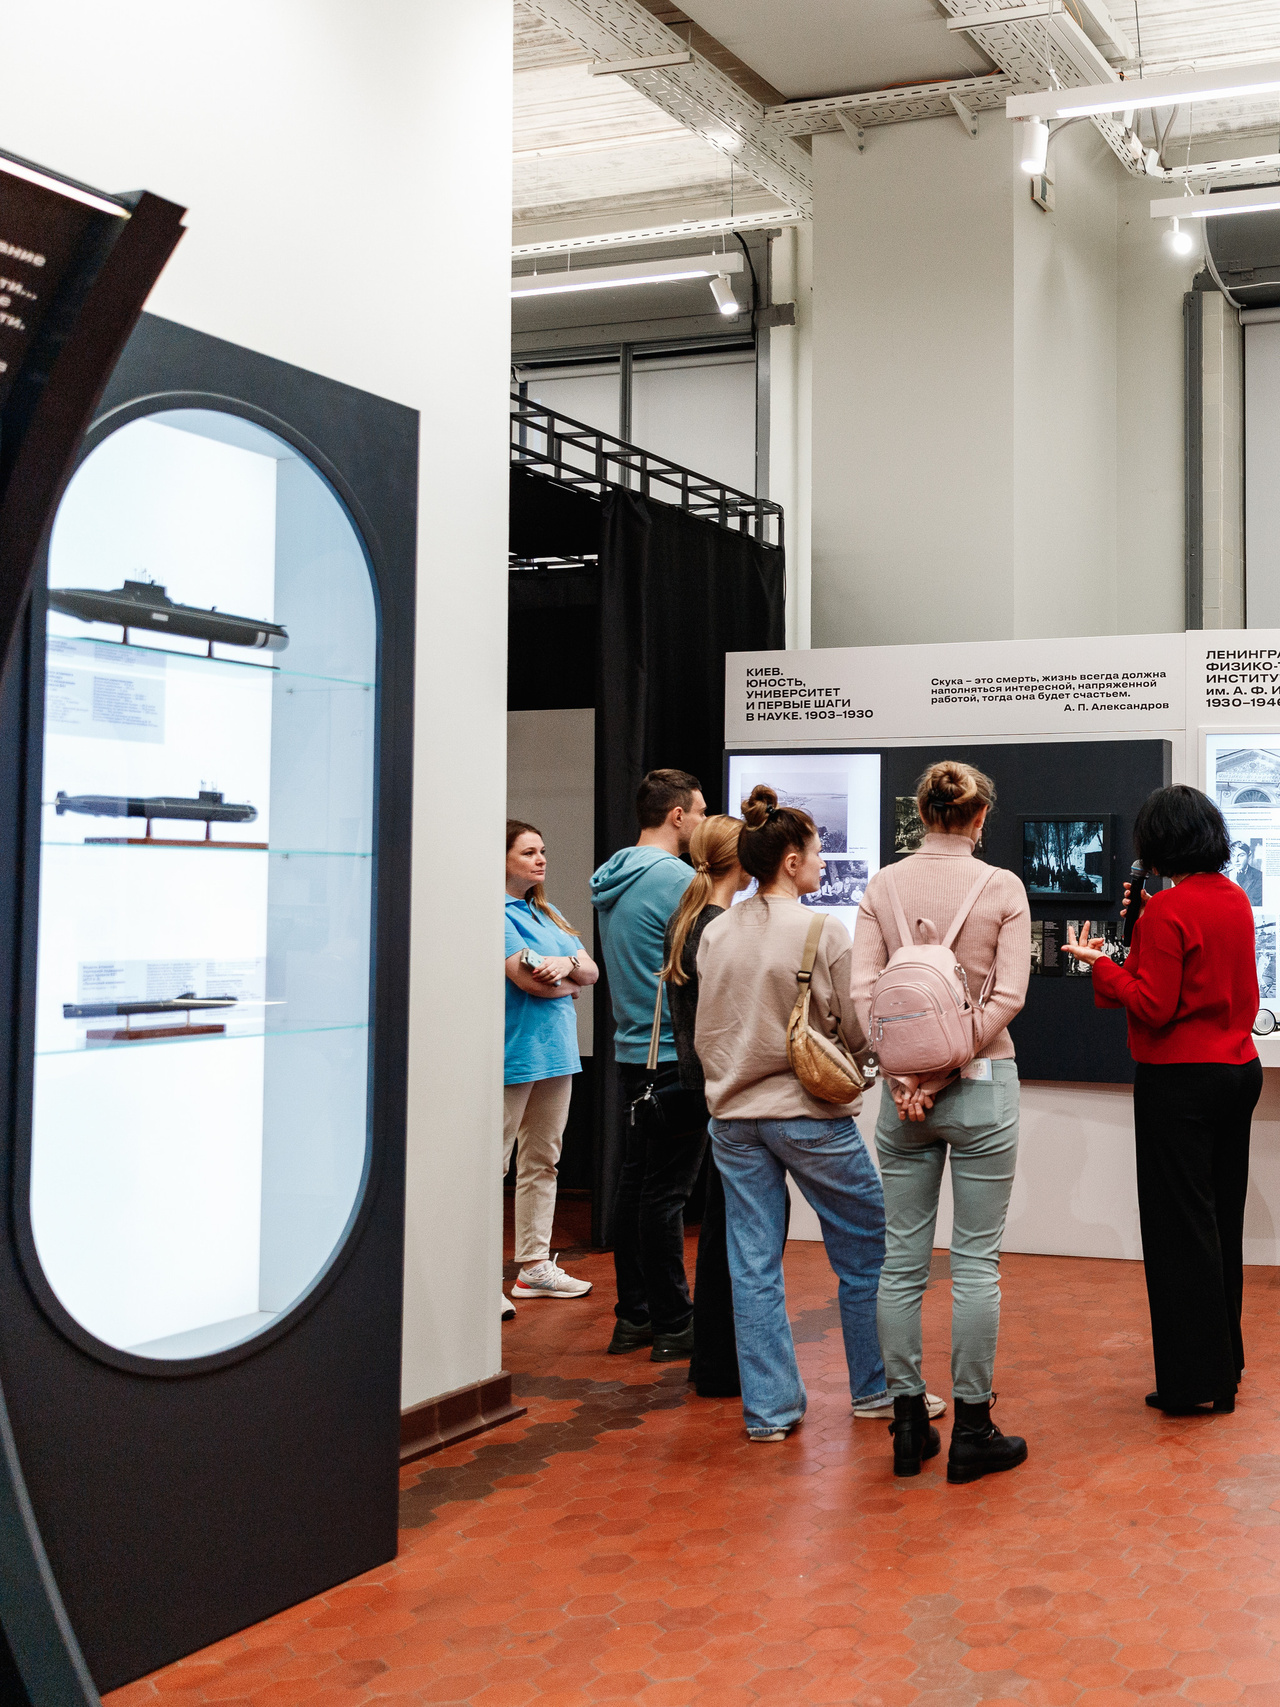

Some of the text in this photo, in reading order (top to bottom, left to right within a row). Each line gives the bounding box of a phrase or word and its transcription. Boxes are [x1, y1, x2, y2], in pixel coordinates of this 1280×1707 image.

[746, 667, 784, 677] КИЕВ.
[931, 677, 963, 686] Скука
[996, 674, 1040, 685] смерть,
[1041, 673, 1077, 682] жизнь
[1079, 671, 1119, 682] всегда
[1121, 670, 1167, 680] должна
[746, 678, 806, 688] ЮНОСТЬ,
[931, 679, 1157, 695] наполняться интересной, напряженной
[746, 688, 841, 699] УНИВЕРСИТЕТ
[1205, 687, 1230, 696] им.
[1232, 686, 1248, 696] А.
[1250, 685, 1268, 695] Ф.
[931, 690, 1131, 705] работой, тогда она будет счастьем.
[746, 698, 851, 710] И ПЕРВЫЕ ШАГИ
[1063, 701, 1170, 713] А. П. Александров
[746, 709, 874, 721] В НАУКЕ. 1903–1930
